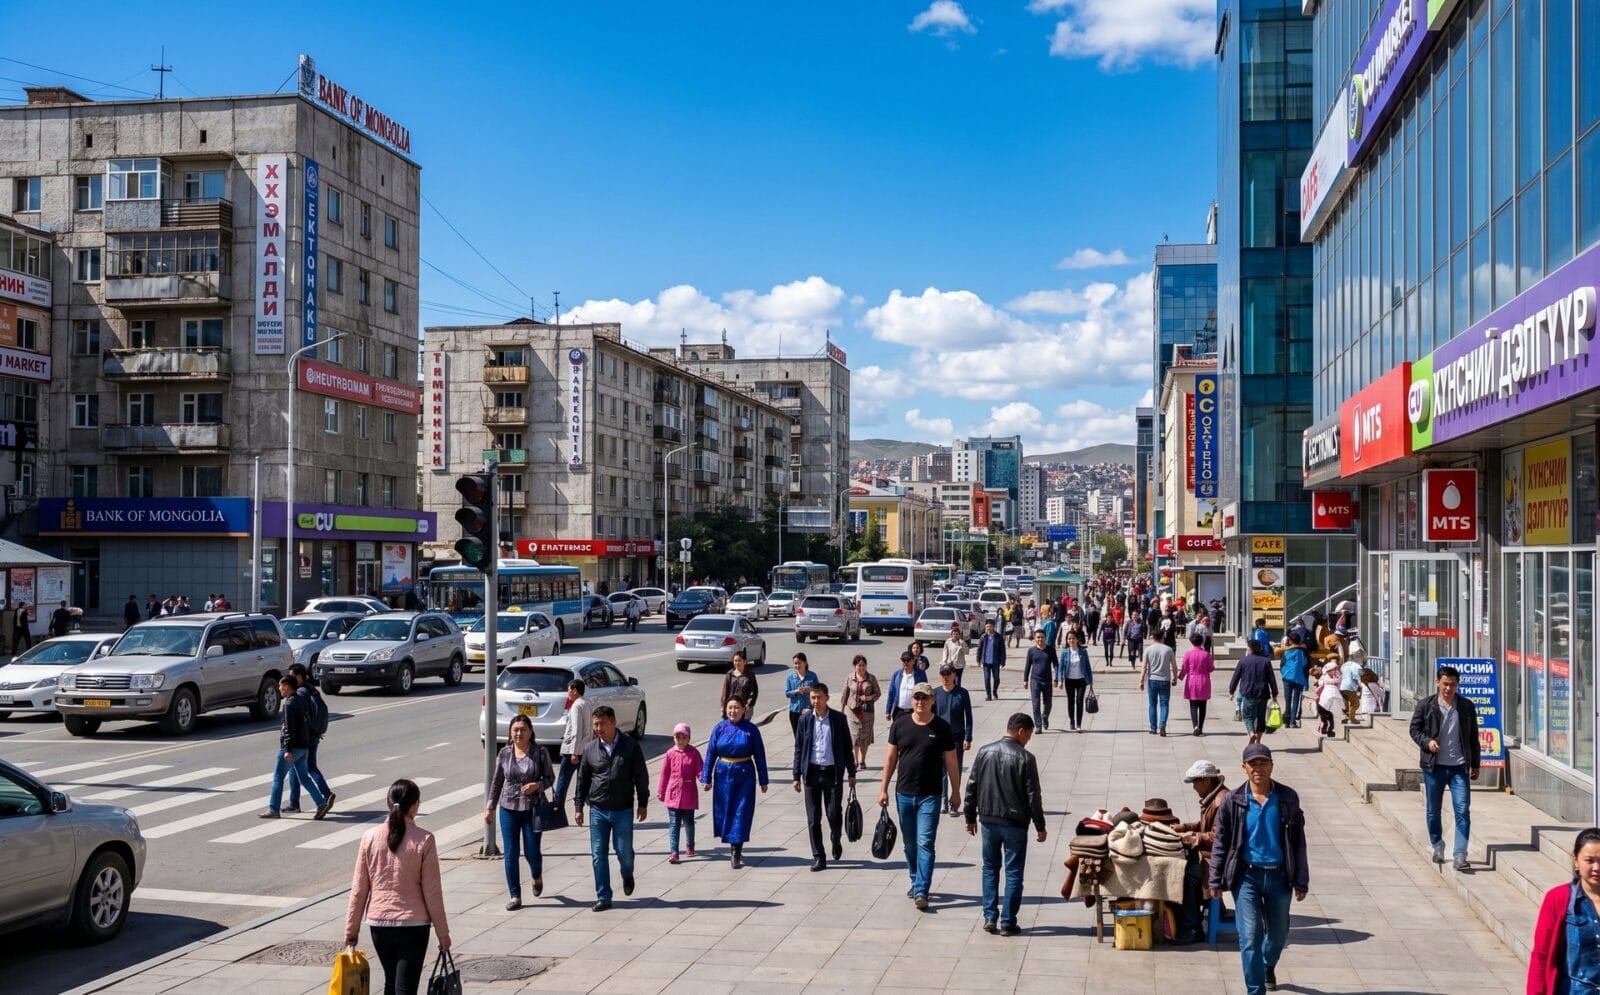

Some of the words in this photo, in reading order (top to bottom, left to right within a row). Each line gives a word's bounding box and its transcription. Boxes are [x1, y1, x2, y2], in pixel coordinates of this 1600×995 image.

[319, 74, 348, 116] BANK
[350, 95, 363, 121] OF
[365, 103, 411, 154] MONGOLIA
[263, 164, 279, 316] ХХЭМАЛДИ
[1433, 327, 1498, 418] ХҮНСНИЙ
[1499, 287, 1597, 400] ДЭЛГҮҮР
[6, 354, 47, 375] MARKET
[1410, 390, 1421, 415] CU
[1362, 403, 1382, 445] MTS
[86, 510, 124, 522] BANK
[127, 510, 146, 522] OF
[149, 510, 225, 522] MONGOLIA
[1328, 506, 1350, 514] MTS
[315, 512, 334, 531] CU
[1432, 516, 1471, 530] MTS
[1254, 540, 1282, 549] CAFE
